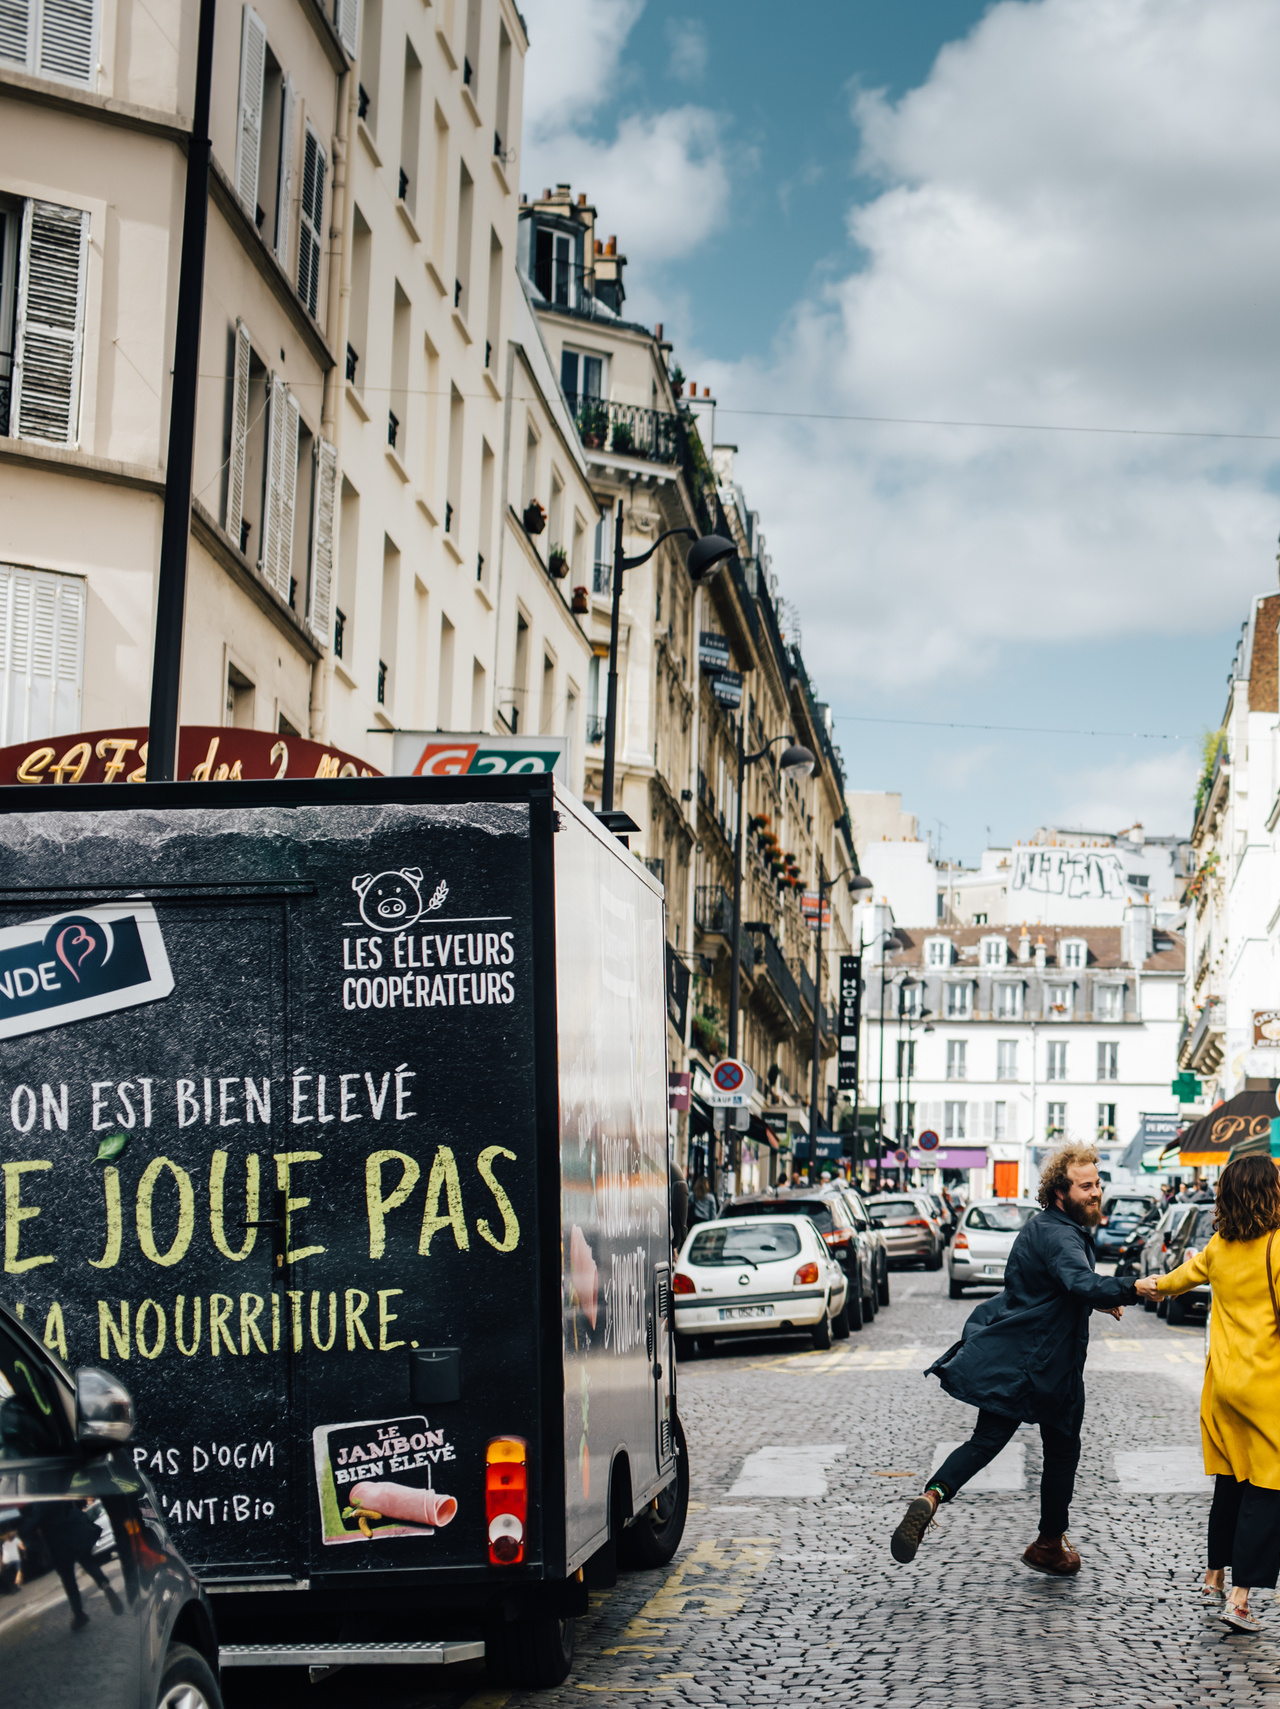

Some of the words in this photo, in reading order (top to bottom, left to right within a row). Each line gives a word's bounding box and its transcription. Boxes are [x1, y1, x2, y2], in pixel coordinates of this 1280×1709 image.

[421, 749, 546, 776] G20
[342, 936, 383, 971] LES
[394, 931, 515, 968] ÉLEVEURS
[342, 971, 515, 1010] COOPÉRATEURS
[842, 978, 857, 1027] HOTEL
[10, 1083, 69, 1132] ON
[91, 1078, 153, 1131] EST
[176, 1077, 271, 1128] BIEN
[291, 1063, 418, 1124] ÉLEVÉ
[88, 1147, 329, 1269] JOUE
[365, 1145, 520, 1260] PAS
[98, 1288, 420, 1361] NOURRITURE.
[337, 1429, 444, 1465] JAMBON
[377, 1426, 400, 1440] LE
[133, 1446, 180, 1475] PAS
[192, 1441, 275, 1474] D'OGM
[335, 1461, 384, 1484] BIEN
[389, 1443, 456, 1473] ÉLEVÉ
